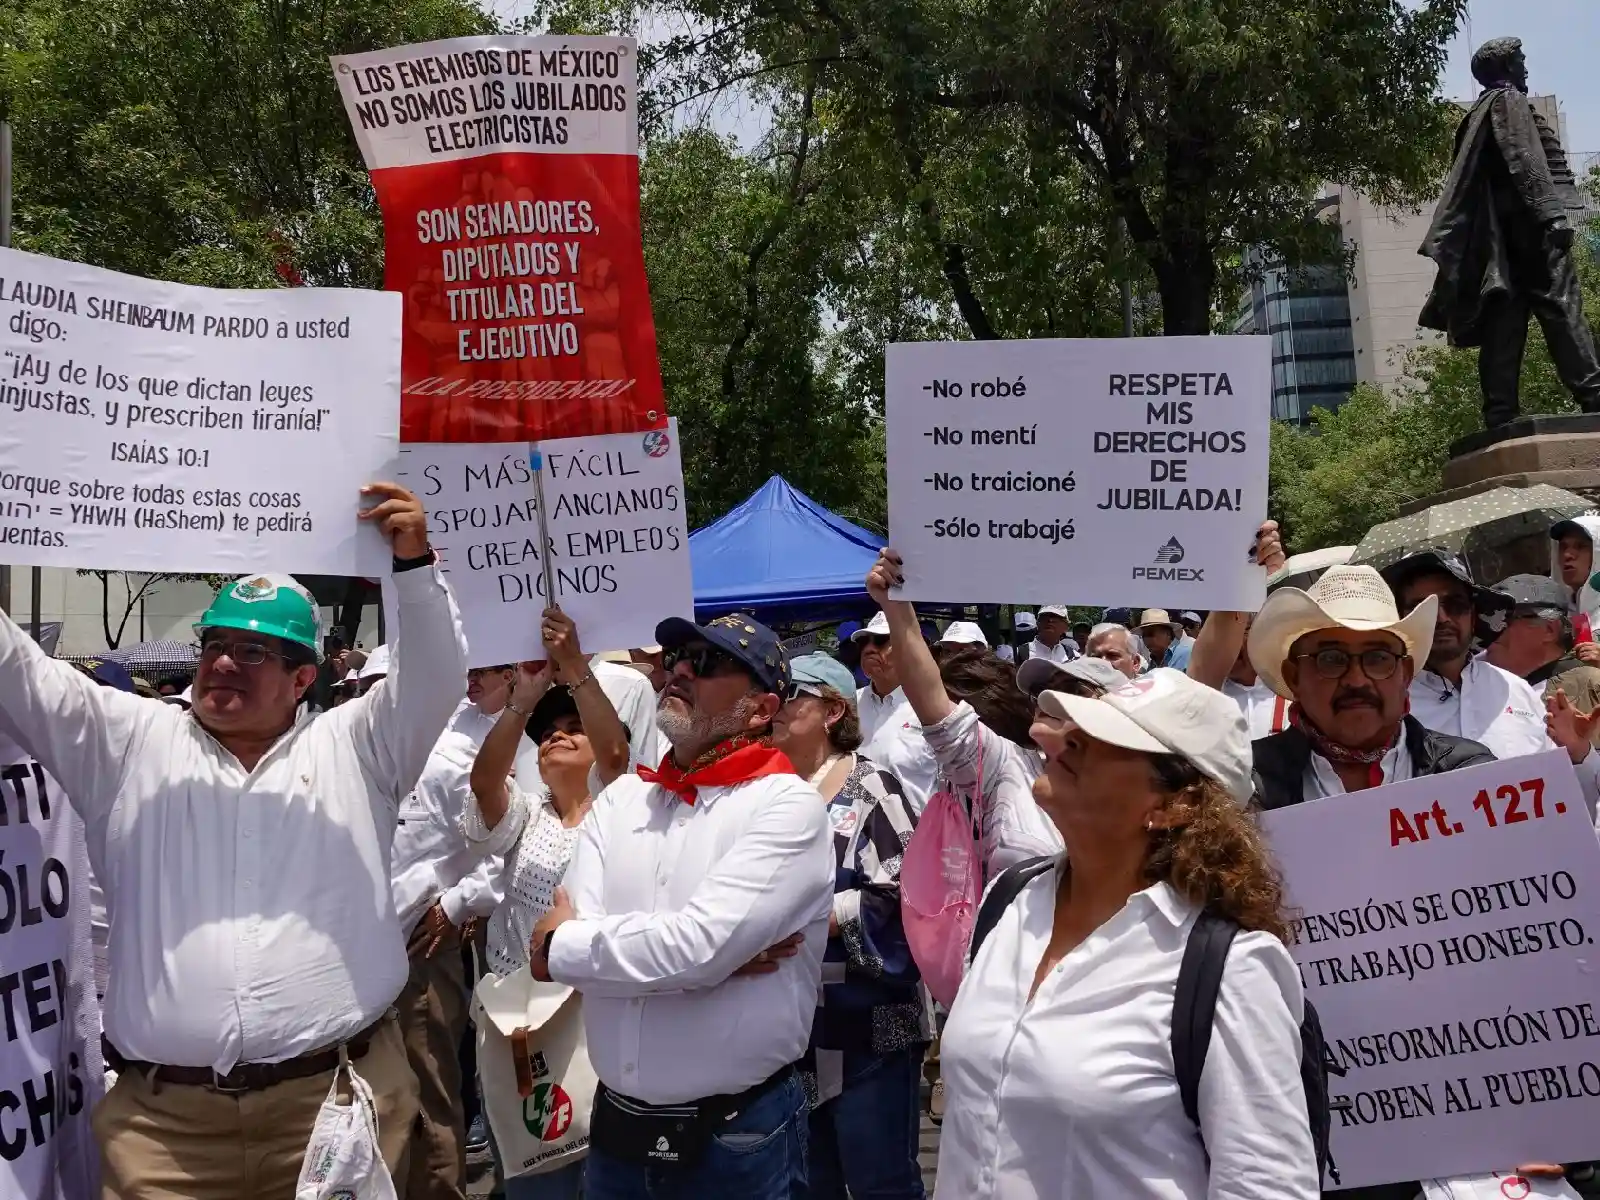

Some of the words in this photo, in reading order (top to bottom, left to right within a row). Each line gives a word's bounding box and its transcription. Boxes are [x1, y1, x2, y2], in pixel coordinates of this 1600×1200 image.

[352, 65, 395, 95] LOS
[396, 50, 502, 88] ENEMIGOS
[507, 50, 533, 76] DE
[540, 45, 618, 78] MÉXICO
[355, 99, 389, 129] NO
[391, 87, 467, 124] SOMOS
[469, 80, 505, 112] LOS
[511, 82, 626, 112] JUBILADOS
[425, 114, 568, 153] ELECTRICISTAS
[416, 207, 460, 243] SON
[464, 200, 601, 238] SENADORES,
[442, 243, 560, 282] DIPUTADOS
[564, 241, 581, 276] Y
[87, 297, 194, 334] SHEINBAUM
[204, 316, 268, 338] PARDO
[277, 322, 288, 338] a
[296, 317, 349, 338] usted
[447, 284, 535, 321] TITULAR
[540, 281, 584, 315] DEL
[10, 310, 67, 343] digo:
[458, 322, 579, 361] EJECUTIVO
[59, 360, 87, 385] de
[96, 365, 128, 392] los
[139, 377, 178, 401] que
[187, 377, 251, 401] dictan
[260, 380, 312, 408] leyes
[923, 380, 962, 398] -No
[971, 376, 1026, 397] robé
[1110, 373, 1233, 395] RESPETA
[106, 401, 118, 425] y
[127, 404, 242, 429] prescriben
[1147, 402, 1193, 424] MIS
[924, 427, 963, 445] -No
[972, 424, 1037, 444] mentí
[1094, 431, 1245, 453] DERECHOS
[111, 440, 169, 465] ISAÍAS
[177, 447, 210, 469] 10:1
[465, 455, 531, 494] MÁS
[547, 449, 640, 480] FÁCIL
[1151, 460, 1187, 482] DE
[0, 471, 60, 498] orque
[68, 479, 124, 501] sobre
[133, 484, 184, 505] todas
[193, 489, 241, 507] estas
[249, 492, 301, 508] cosas
[924, 473, 963, 491] -No
[972, 471, 1075, 491] traicioné
[1097, 488, 1241, 511] JUBILADA!
[71, 504, 126, 527] YHWH
[134, 508, 224, 532] (HaShem)
[233, 513, 249, 531] te
[257, 512, 312, 536] pedirá
[424, 498, 538, 534] SPOJAR
[553, 485, 679, 520] ANCIANOS
[467, 536, 559, 572] CREAR
[566, 526, 681, 558] EMPLEOS
[924, 517, 980, 537] -Sólo
[989, 519, 1075, 544] trabajé
[1133, 567, 1204, 581] PEMEX
[1387, 799, 1465, 848] Art.
[1472, 778, 1568, 829] 127.
[1291, 897, 1408, 946] PENSIÓN
[1411, 893, 1450, 926] SE
[1450, 869, 1578, 918] OBTUVO
[1309, 943, 1434, 986] TRABAJO
[1437, 919, 1593, 965] HONESTO.
[1552, 1003, 1600, 1040] DE
[1333, 1083, 1434, 1128] ROBEN
[1442, 1077, 1482, 1116] AL
[1482, 1060, 1600, 1109] PUEBLO
